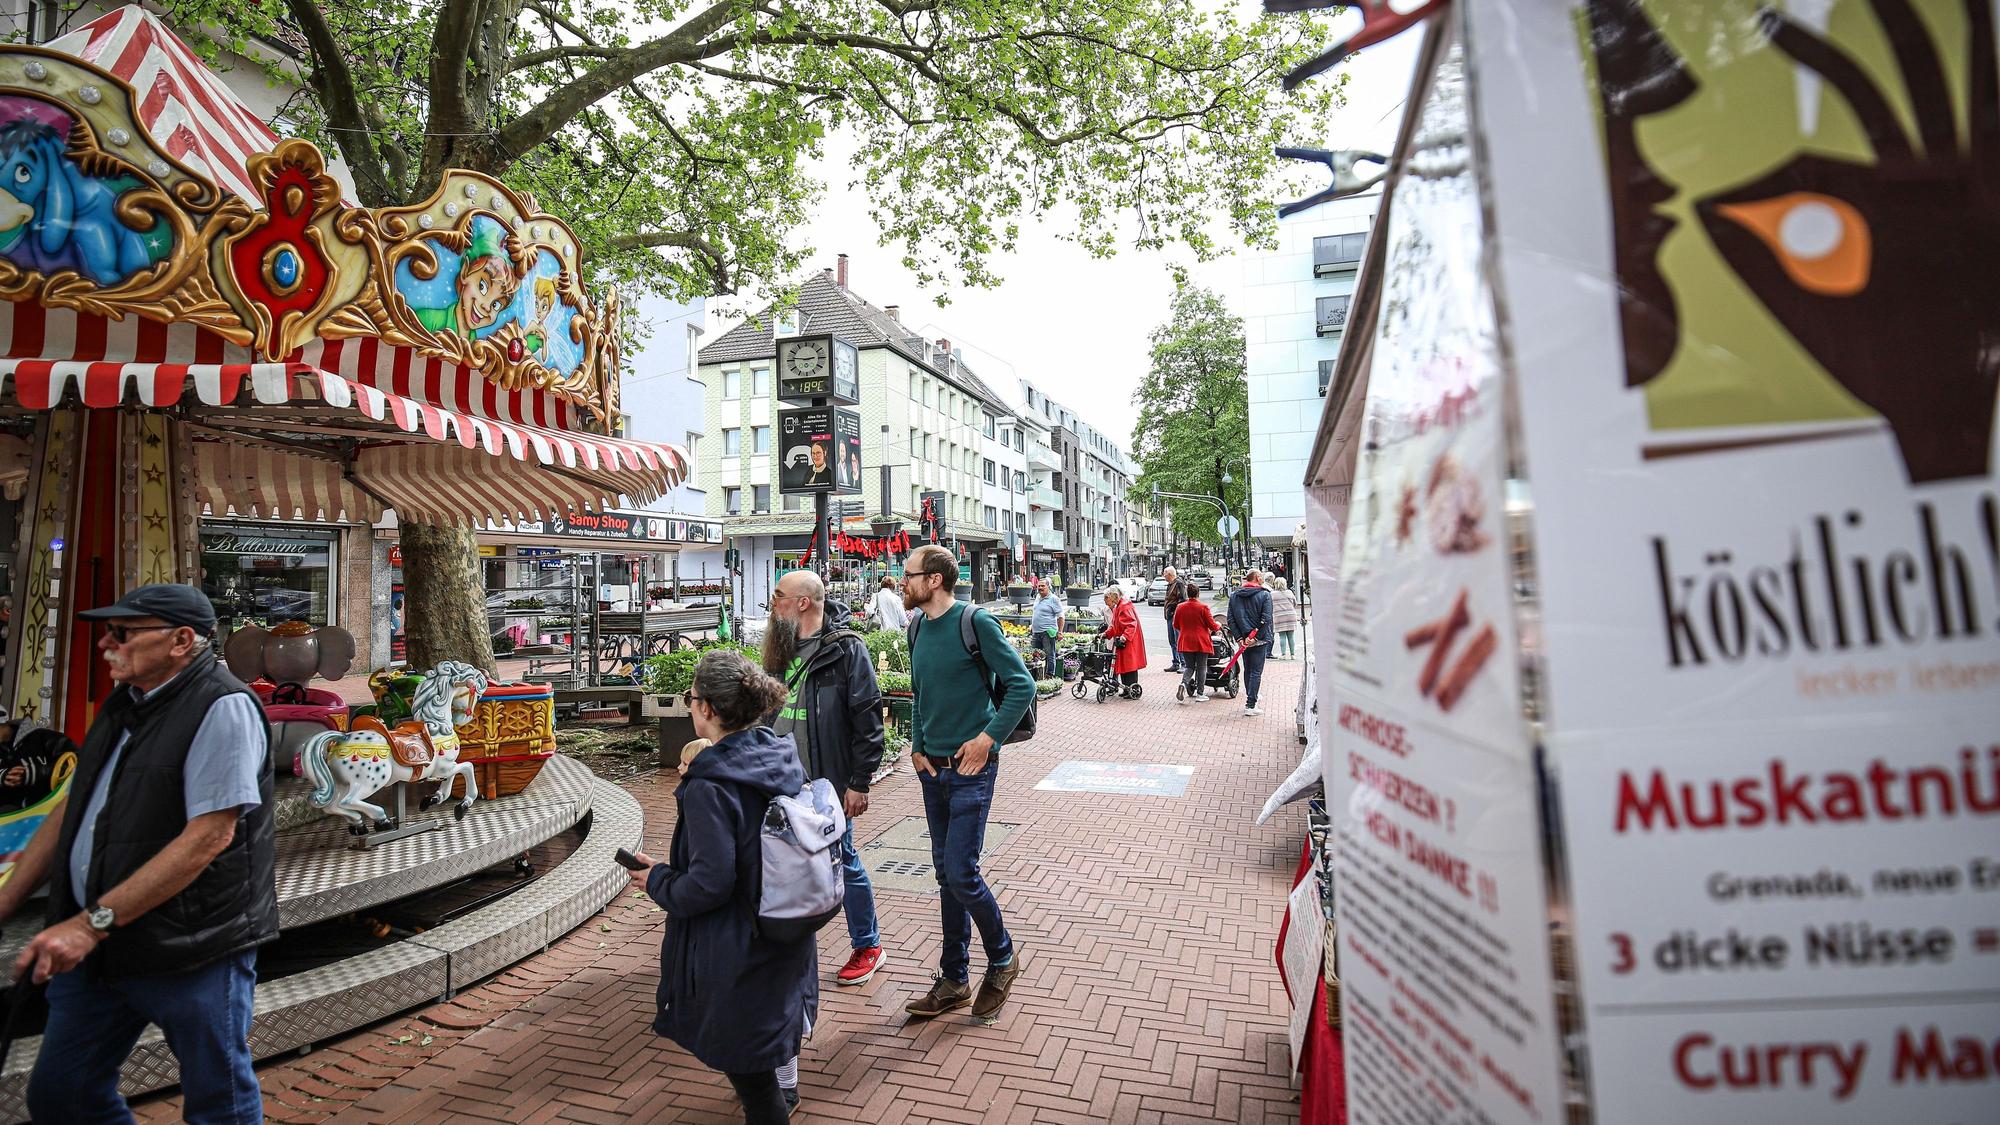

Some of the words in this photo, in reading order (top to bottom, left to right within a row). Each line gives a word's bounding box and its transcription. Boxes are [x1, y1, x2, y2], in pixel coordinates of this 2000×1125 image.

[519, 523, 540, 531] NOKIA
[568, 511, 600, 529] Samy
[601, 515, 629, 532] Shop
[568, 528, 584, 536] Handy
[584, 529, 606, 537] Reparatur
[206, 534, 307, 553] Bellissimo
[1610, 932, 1636, 974] 3
[1655, 929, 1788, 972] dicke
[1804, 919, 1956, 967] Nüsse
[1672, 1034, 1866, 1104] Curry
